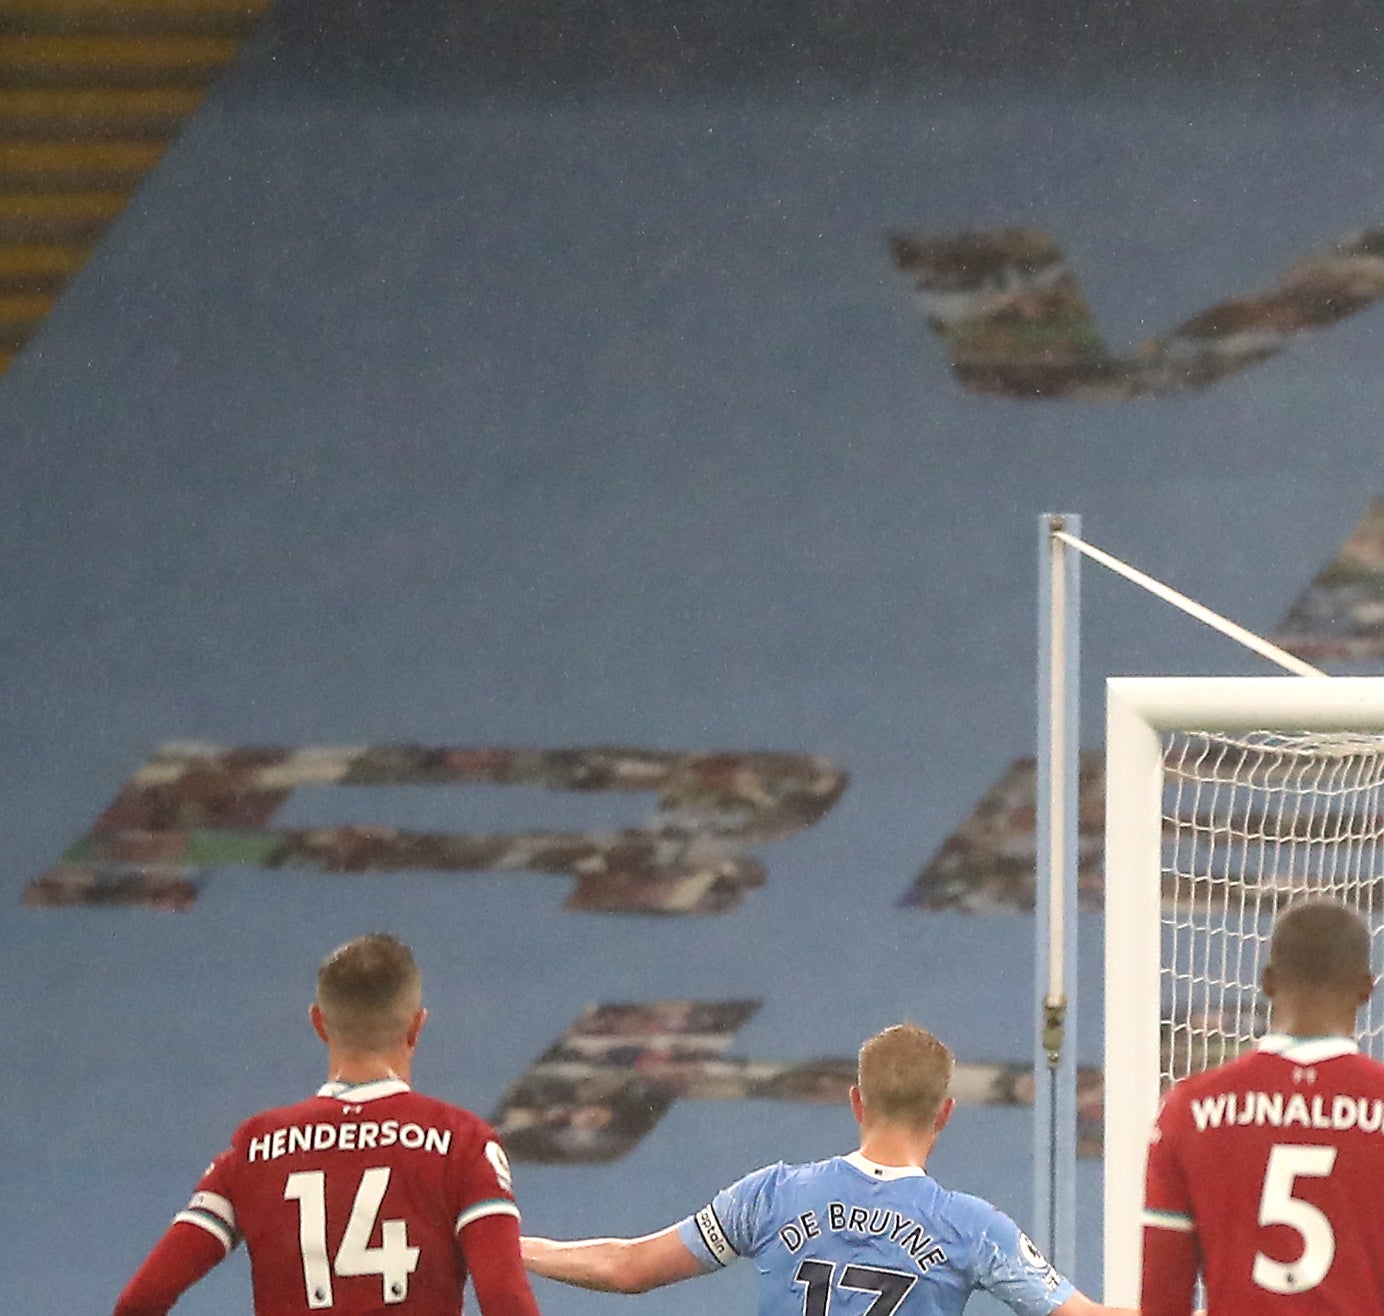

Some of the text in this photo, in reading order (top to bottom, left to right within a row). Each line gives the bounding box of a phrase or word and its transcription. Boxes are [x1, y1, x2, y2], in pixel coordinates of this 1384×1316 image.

[248, 1120, 451, 1162] HENDERSON
[284, 1167, 420, 1310] 14
[700, 1211, 725, 1254] aptain
[778, 1201, 948, 1273] DE BRUYNE
[1252, 1143, 1338, 1295] 5
